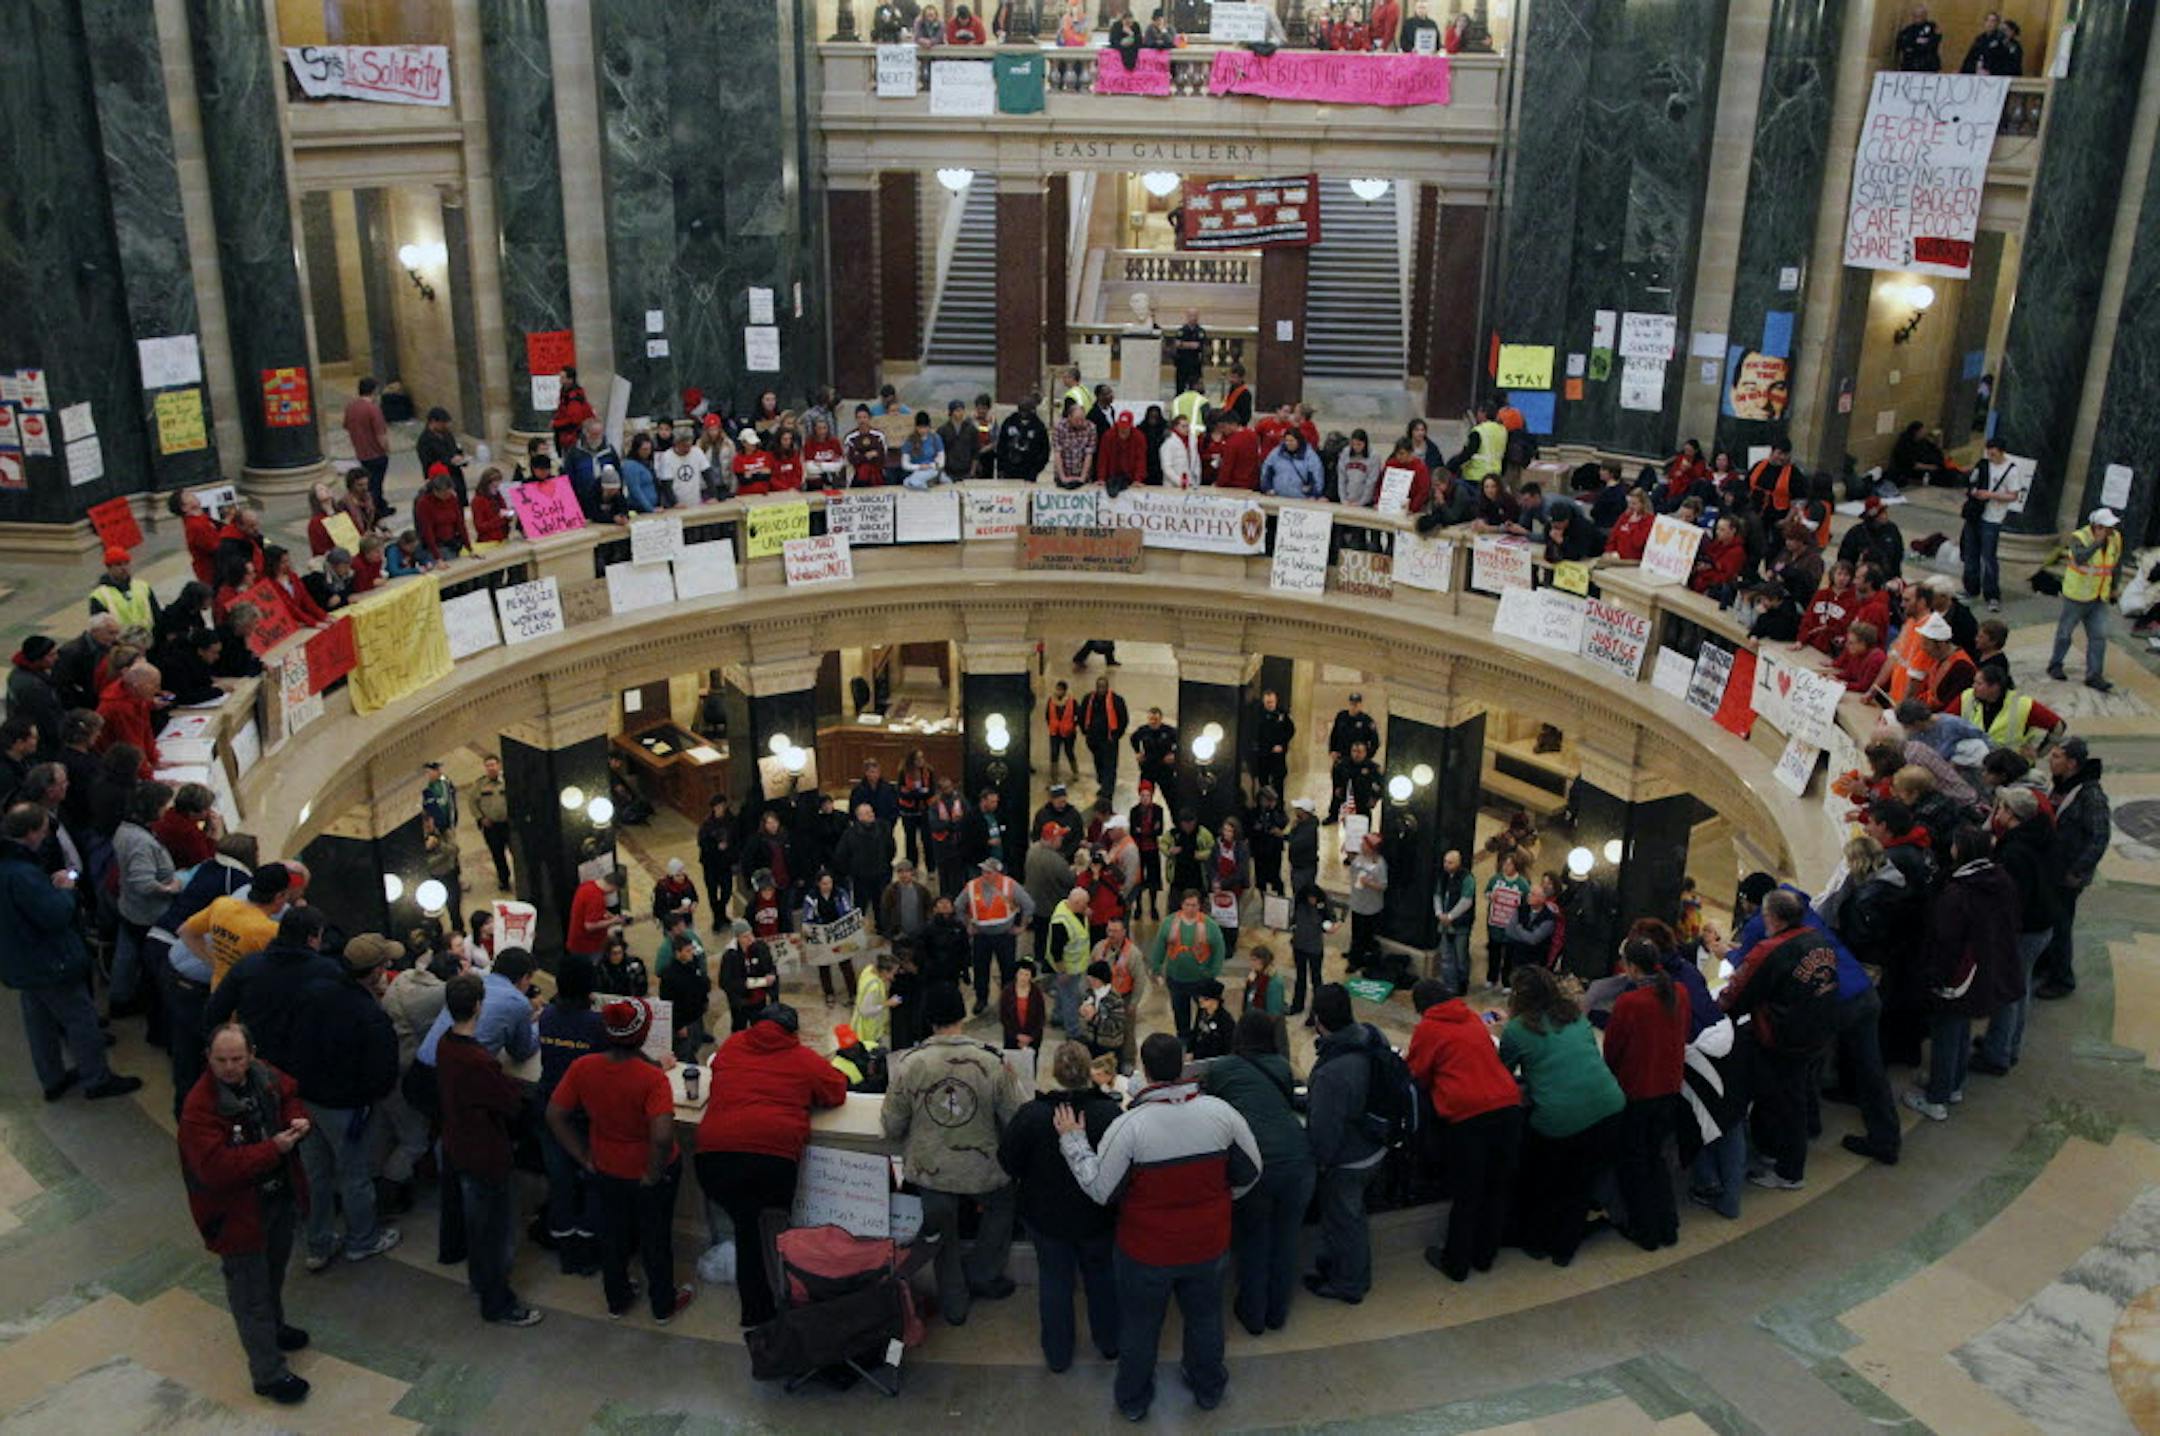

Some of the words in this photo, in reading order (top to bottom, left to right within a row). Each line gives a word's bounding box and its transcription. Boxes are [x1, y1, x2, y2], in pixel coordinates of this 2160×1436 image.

[1879, 75, 2005, 104] FREEDOM
[1872, 114, 1949, 144] PEOPLE
[1957, 122, 1994, 152] OF
[1054, 142, 1114, 158] EAST
[1132, 143, 1257, 161] GALLERY
[1864, 137, 1933, 165] COLOR
[1861, 165, 1945, 187] OCCUPYING
[1949, 166, 1972, 187] TO
[1859, 183, 1907, 208] SAVE
[1911, 184, 1979, 216] BADGER
[1847, 234, 1898, 260] SHARE
[1505, 375, 1544, 386] STAY
[516, 487, 532, 504] I
[1036, 493, 1094, 511] UNION
[531, 500, 565, 520] Scott
[1133, 501, 1216, 516] DEPARTMENT
[1083, 528, 1116, 537] COAST
[1098, 508, 1237, 537] GEOGRAPHY
[1342, 550, 1371, 571] YOU
[1339, 566, 1392, 589] SILENCE
[511, 608, 556, 627] WORKING
[1585, 598, 1647, 636] INJUSTICE
[521, 621, 553, 636] CLASS
[1591, 630, 1639, 661] JUSTICE
[1758, 655, 1775, 692] I
